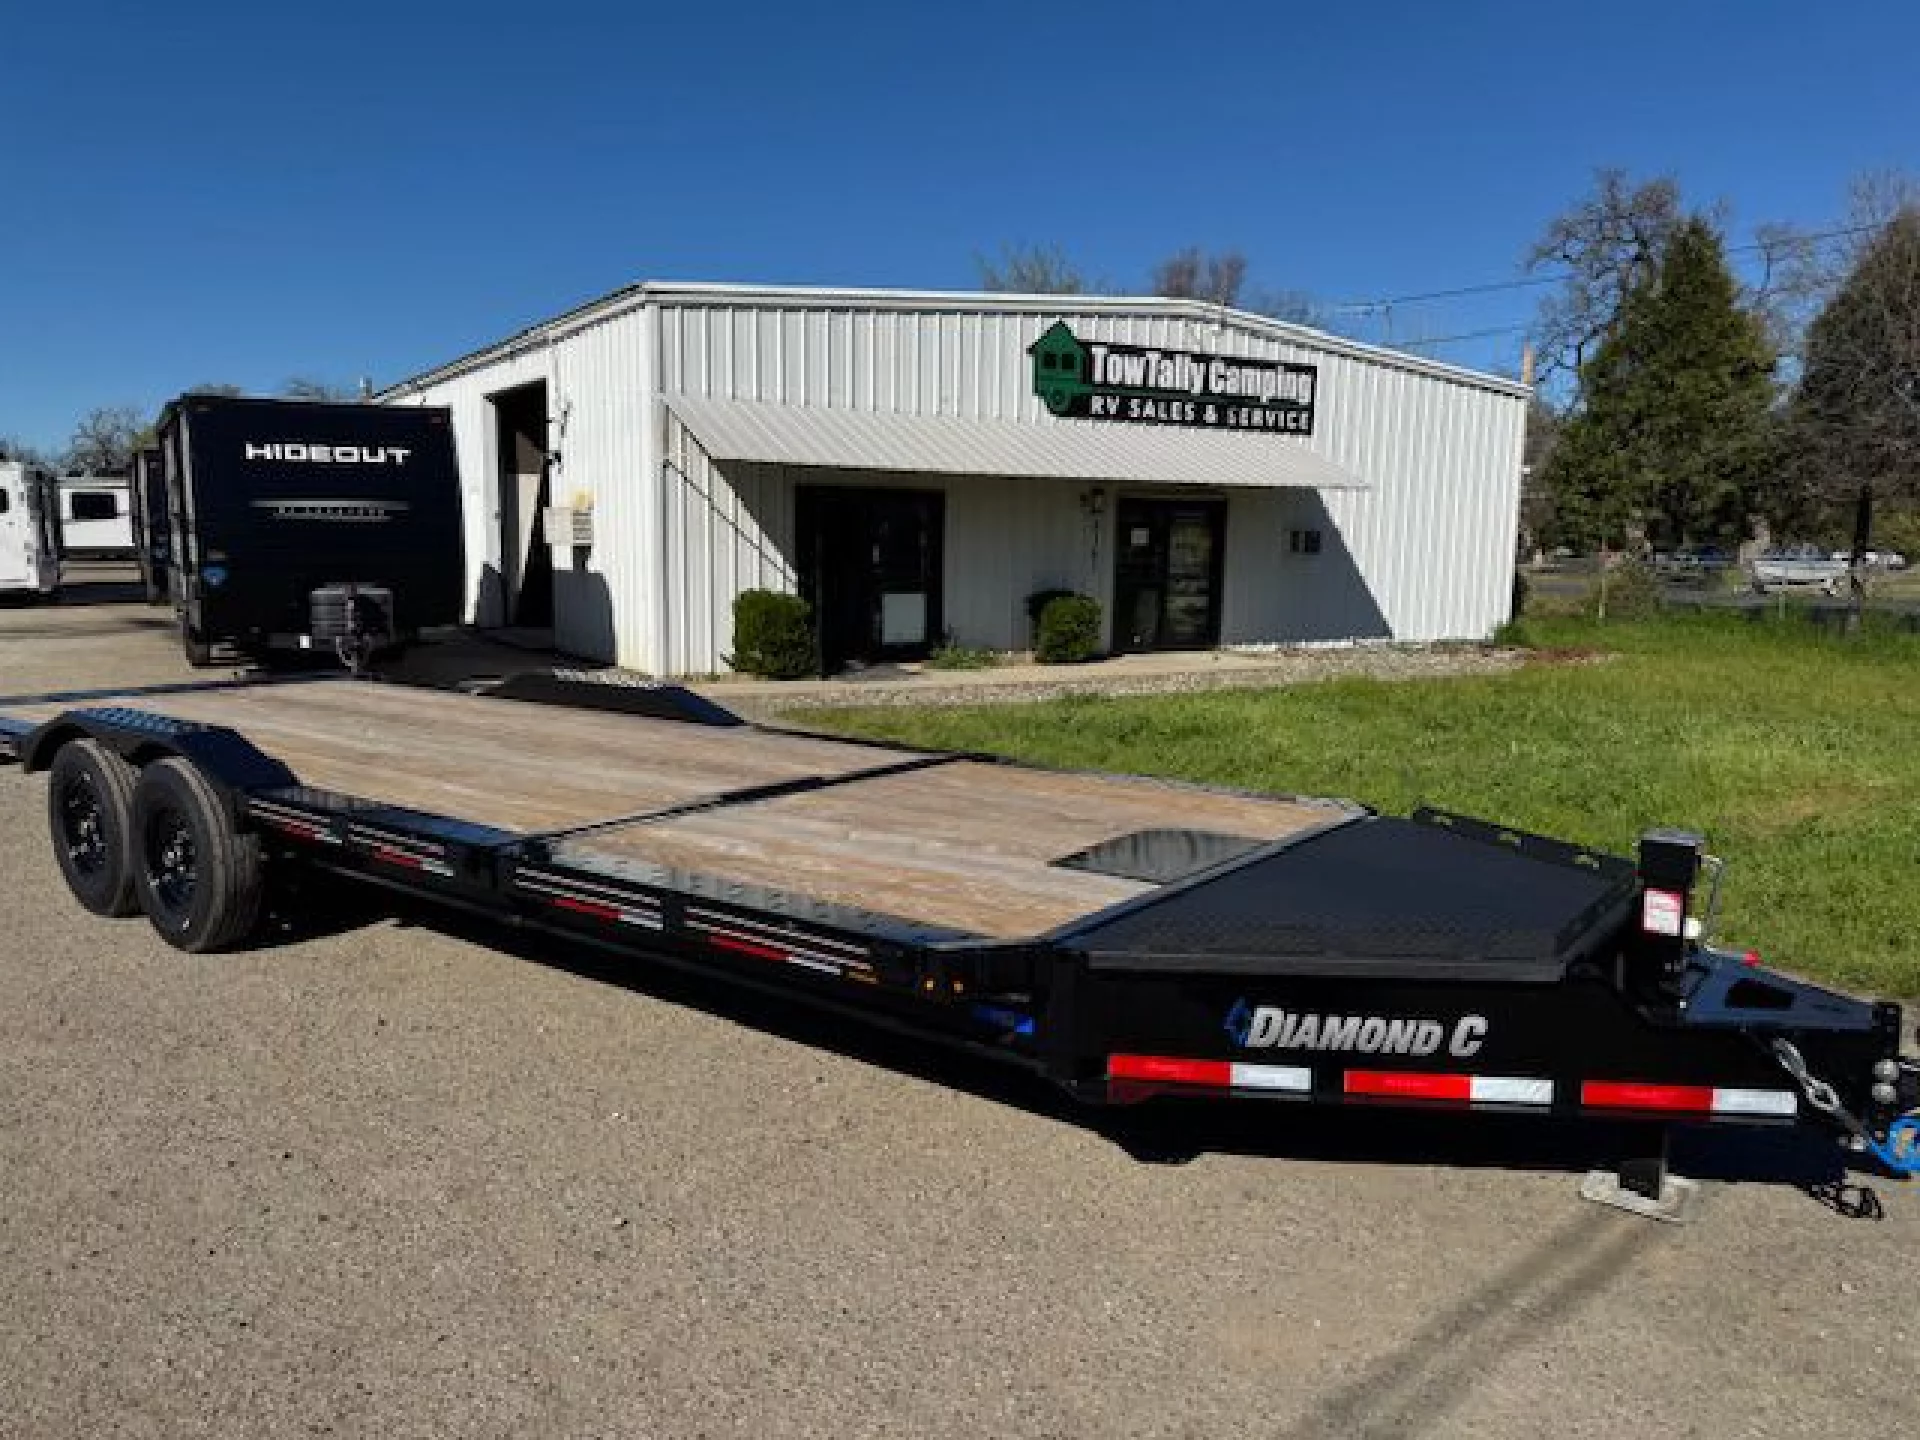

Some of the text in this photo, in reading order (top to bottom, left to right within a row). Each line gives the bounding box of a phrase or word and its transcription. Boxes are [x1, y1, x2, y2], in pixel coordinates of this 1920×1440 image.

[1091, 347, 1313, 405] TowTally Camping
[1091, 396, 1309, 429] RV SALES & SERVICE
[246, 443, 411, 465] HIDEOUT
[1246, 1006, 1488, 1056] DIAMOND C
